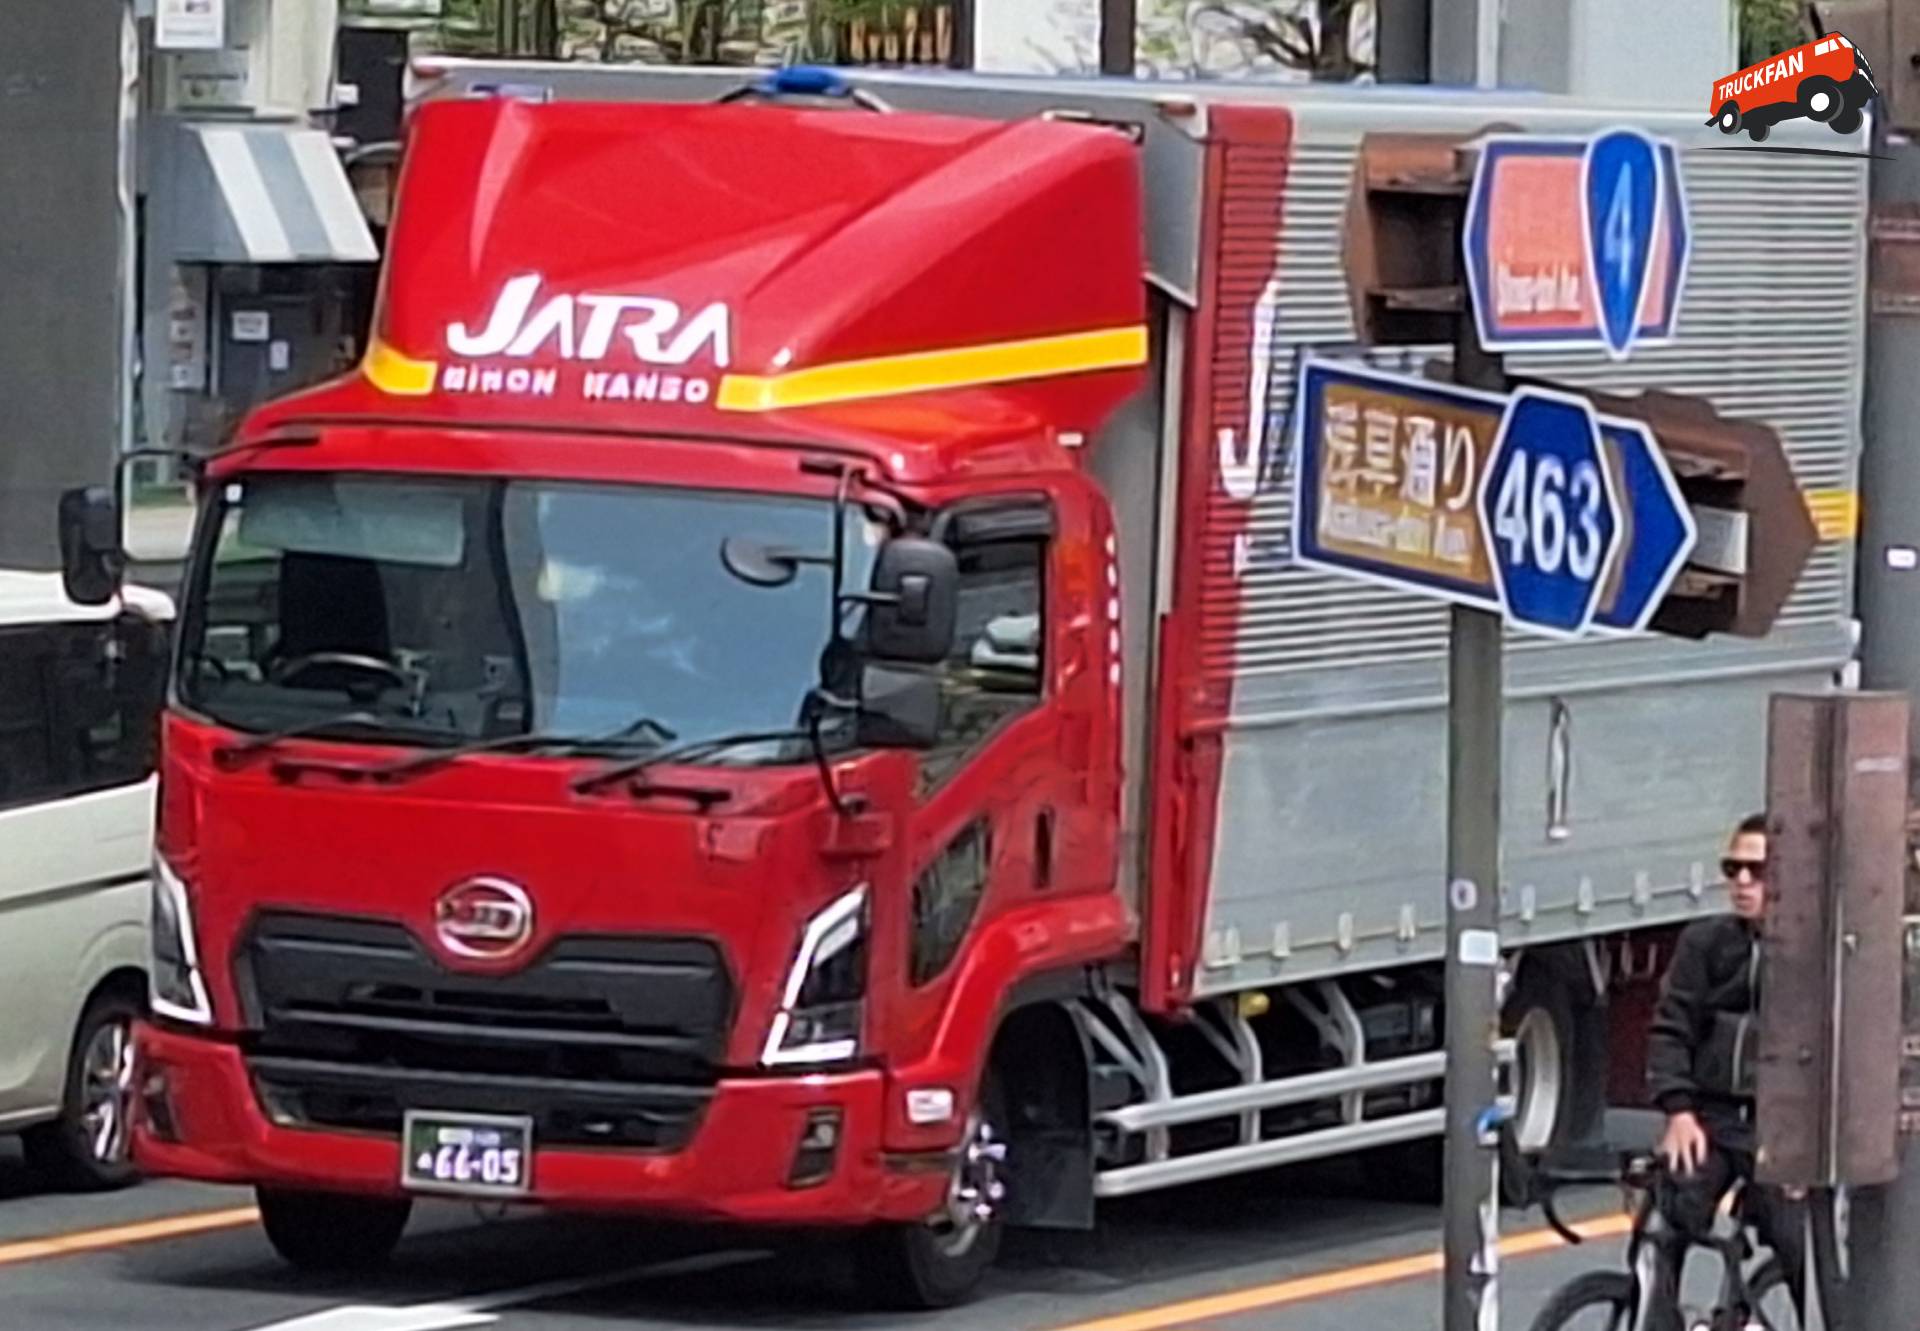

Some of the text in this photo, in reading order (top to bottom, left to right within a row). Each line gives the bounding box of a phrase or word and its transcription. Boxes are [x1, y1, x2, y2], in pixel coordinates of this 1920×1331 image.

[1604, 161, 1633, 290] 4
[446, 273, 729, 367] JATRA
[442, 361, 557, 394] NIHON
[1494, 449, 1600, 581] 463
[434, 1145, 520, 1183] 66-05
